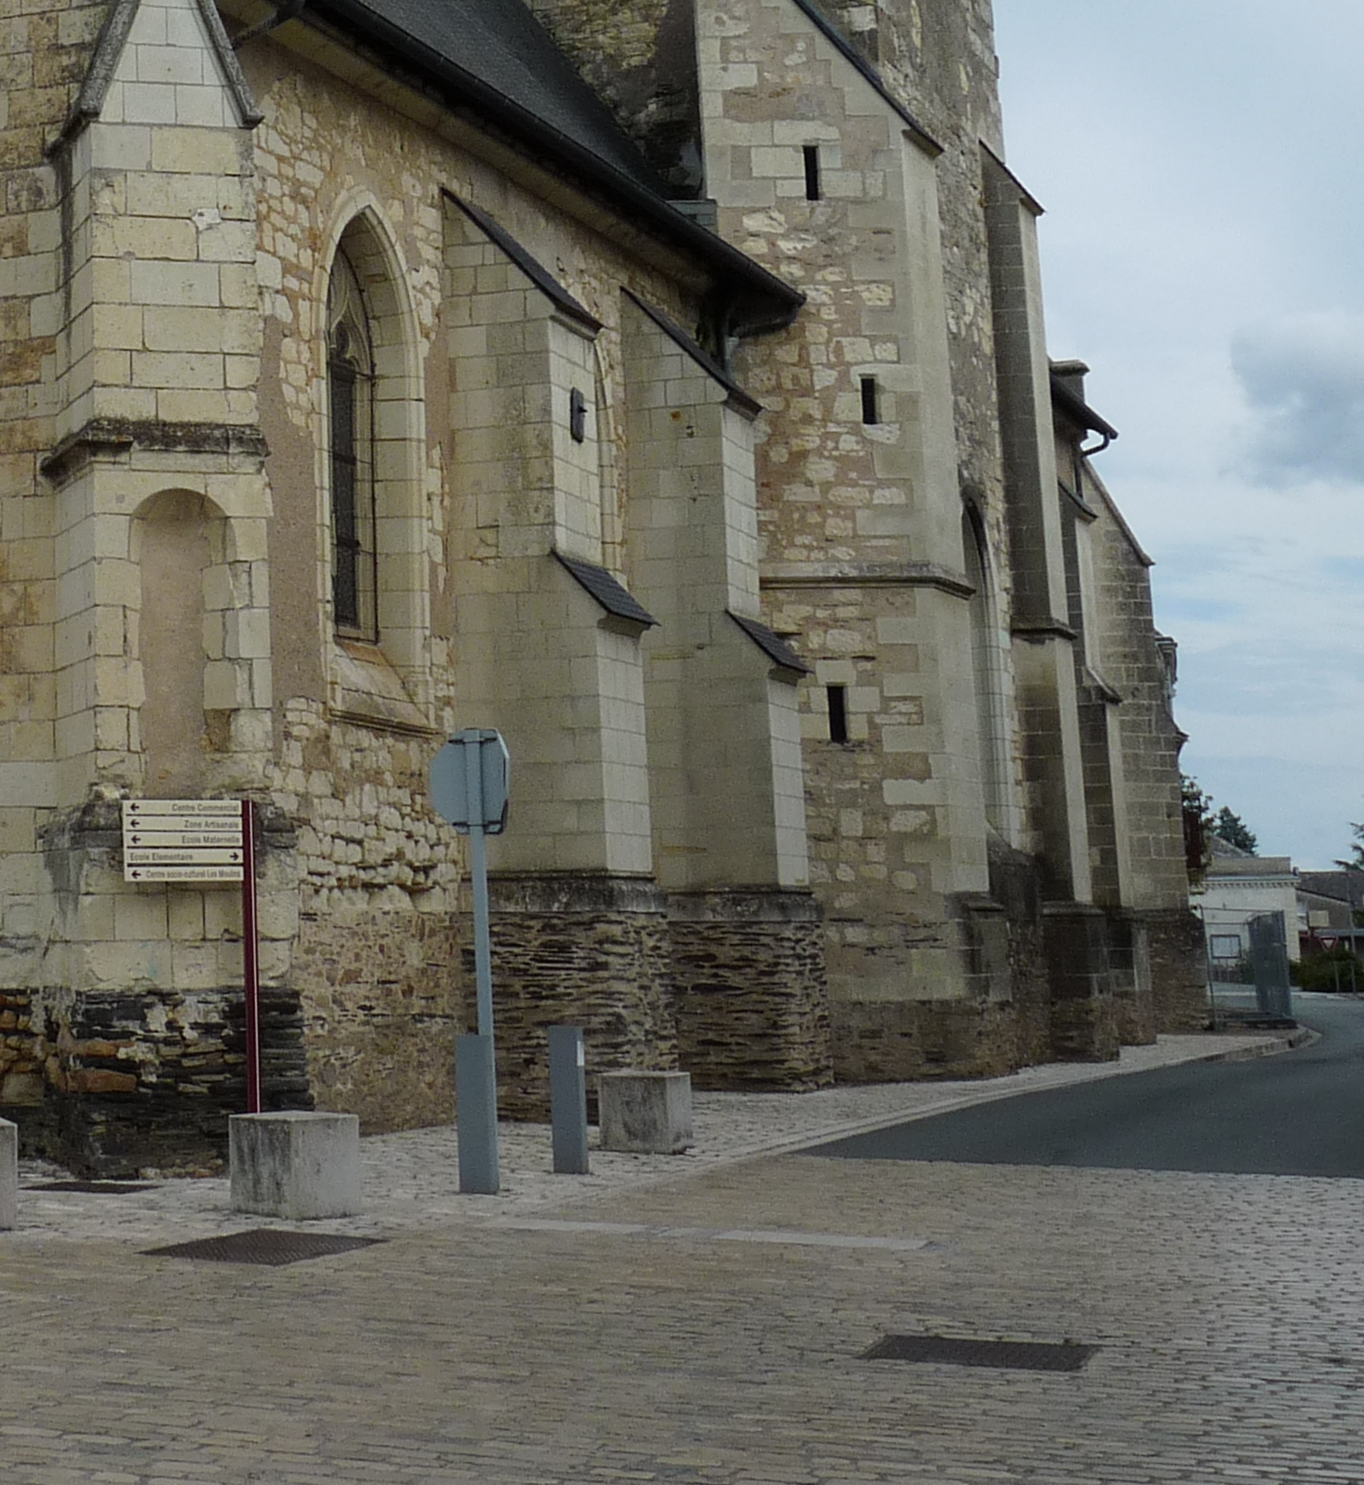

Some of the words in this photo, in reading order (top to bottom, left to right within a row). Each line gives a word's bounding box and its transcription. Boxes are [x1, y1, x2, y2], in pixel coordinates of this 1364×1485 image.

[171, 803, 195, 812] Centre
[197, 803, 239, 812] Commercial
[183, 819, 203, 829] Zone
[204, 820, 239, 829] Artisanale
[181, 835, 201, 844] Ecole
[203, 835, 240, 844] Maternelle
[130, 852, 150, 861] Ecole
[152, 852, 193, 861] Elementaire
[145, 870, 166, 879] Centre
[207, 870, 217, 878] Les
[218, 869, 241, 878] Moulins
